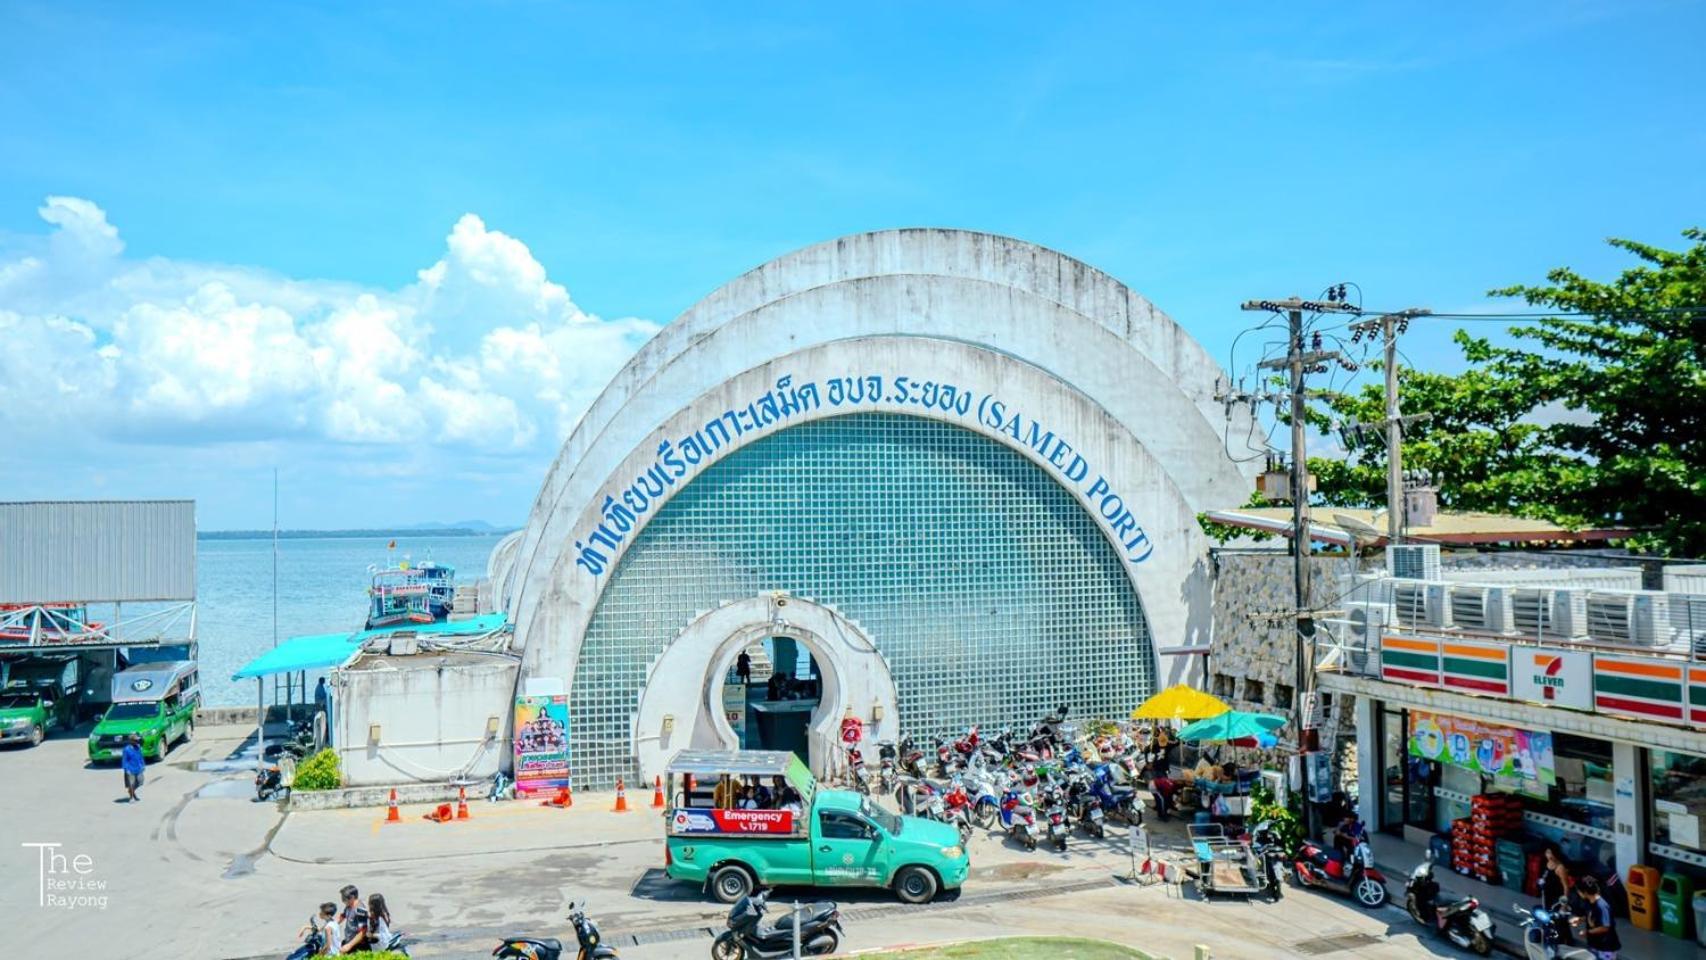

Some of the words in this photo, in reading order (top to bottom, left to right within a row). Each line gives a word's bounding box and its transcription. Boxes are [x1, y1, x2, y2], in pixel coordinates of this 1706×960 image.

[827, 375, 972, 416] อบจ.ระยอง
[977, 394, 1089, 483] (SAMED
[1085, 474, 1155, 565] PORT)
[1534, 655, 1562, 700] 7
[723, 810, 783, 822] Emergency
